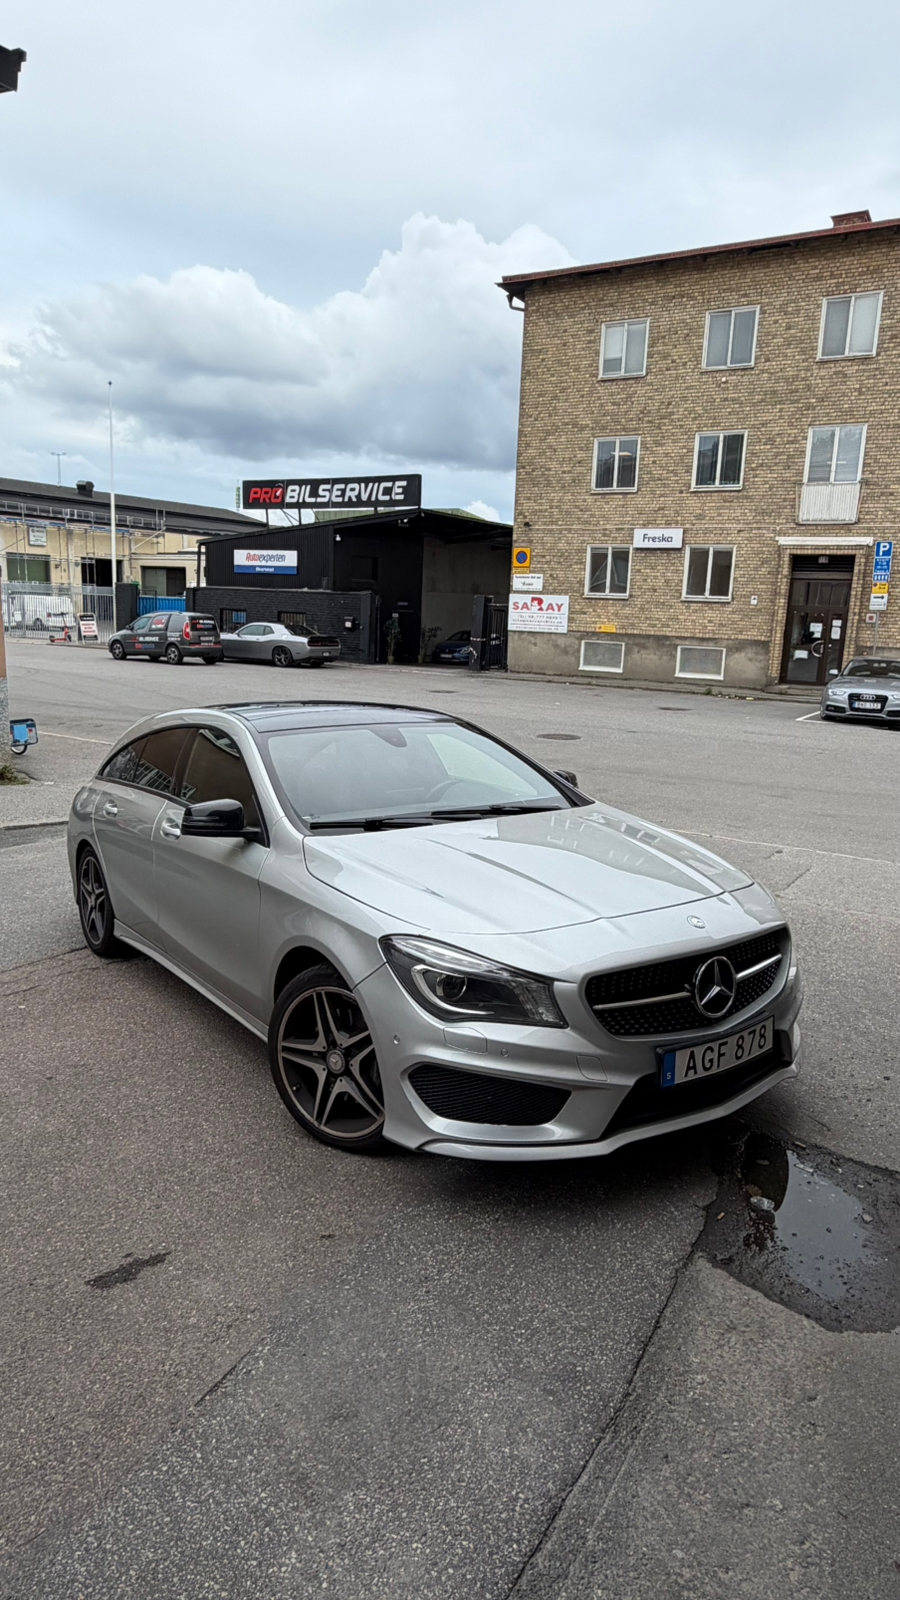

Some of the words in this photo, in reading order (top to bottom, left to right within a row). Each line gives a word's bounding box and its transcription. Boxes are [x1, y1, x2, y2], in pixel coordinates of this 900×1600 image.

[285, 481, 407, 503] BILSERVICE
[642, 534, 673, 543] Freska
[879, 542, 890, 556] P
[512, 597, 564, 612] SARAY
[684, 1041, 728, 1078] AGF
[734, 1024, 767, 1060] 878
